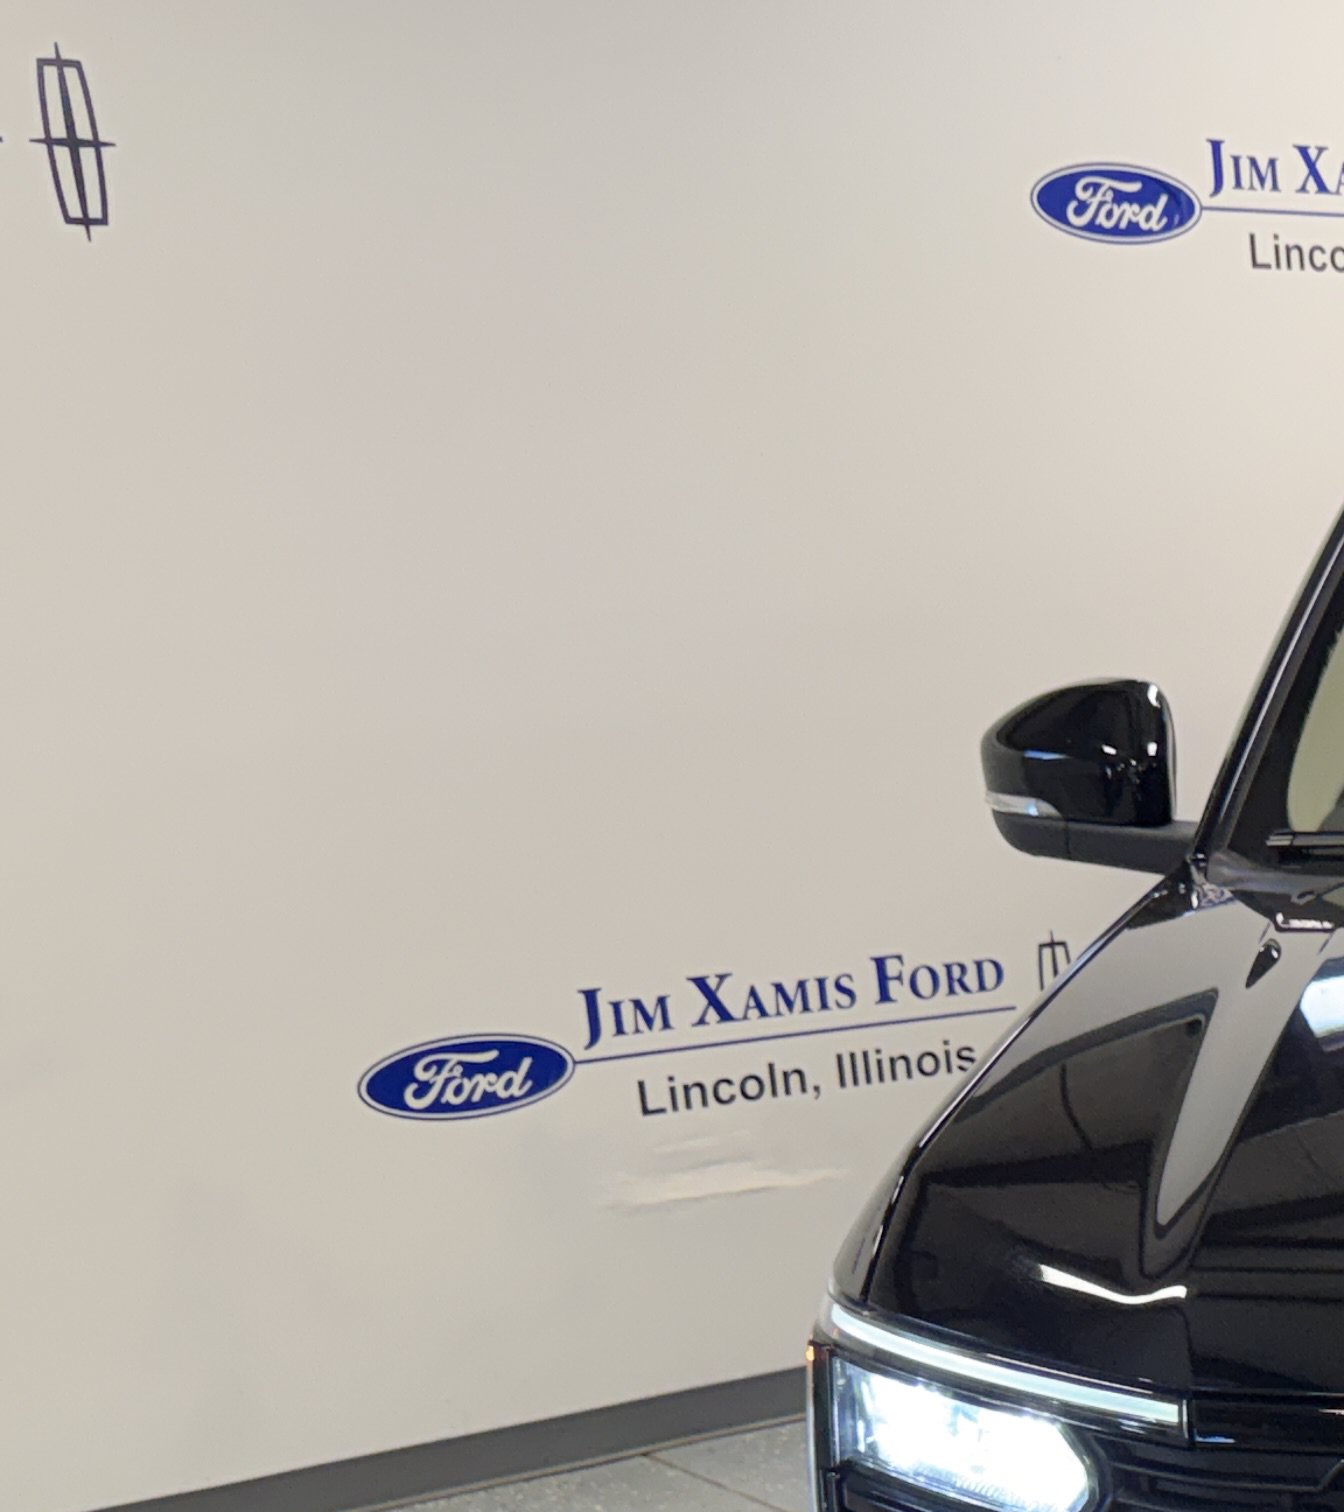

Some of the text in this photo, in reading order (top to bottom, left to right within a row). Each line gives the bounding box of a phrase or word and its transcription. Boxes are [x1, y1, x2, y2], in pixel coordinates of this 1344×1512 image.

[1206, 138, 1280, 198] JIM
[1066, 176, 1168, 232] Ford
[577, 955, 1003, 1050] JIM XAMIS FORD
[405, 1050, 533, 1110] Ford
[638, 1038, 976, 1116] Lincoln, Illinois
